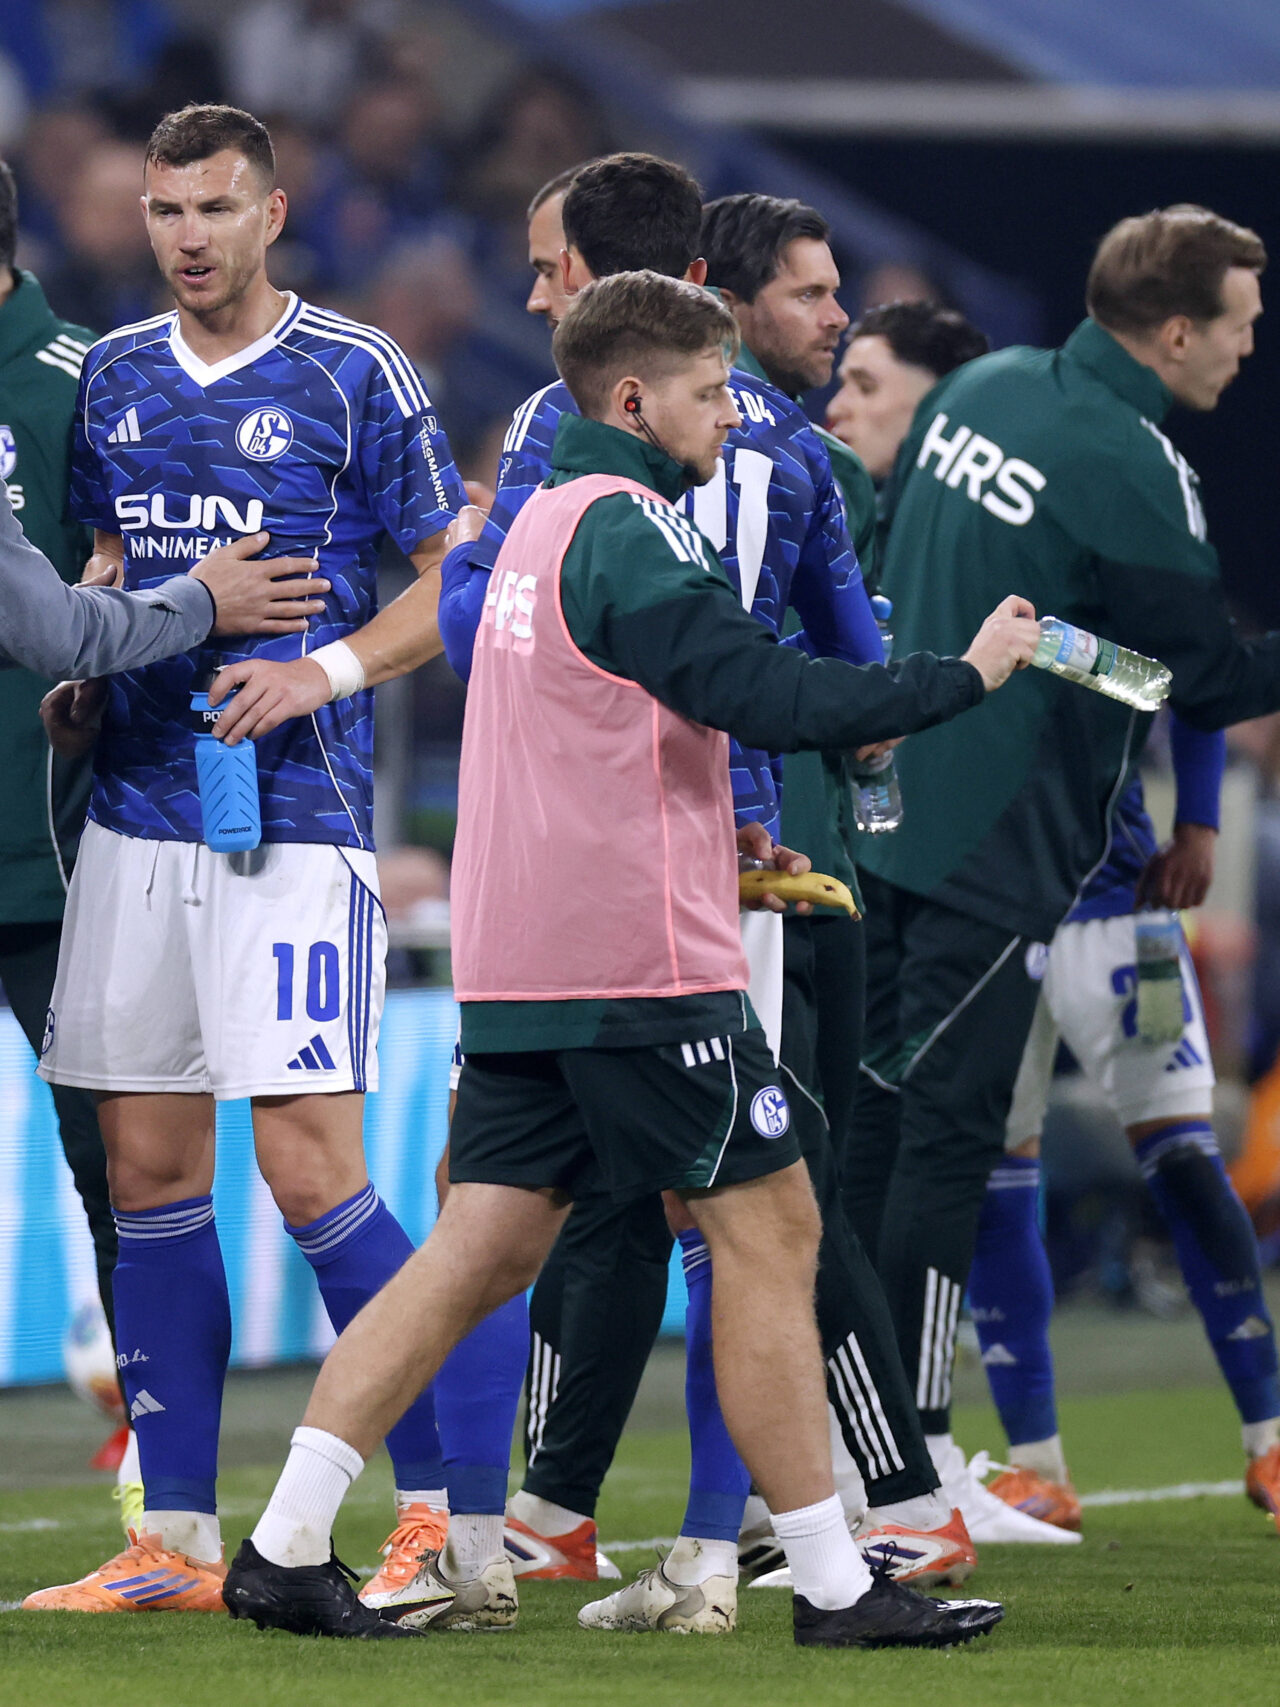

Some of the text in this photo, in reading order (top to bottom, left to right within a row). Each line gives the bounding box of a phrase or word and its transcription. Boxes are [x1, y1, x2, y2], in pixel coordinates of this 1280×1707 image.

[6, 484, 25, 511] S
[419, 427, 450, 511] HEGMANNS
[916, 411, 1047, 526] HRS
[114, 492, 264, 534] SUN
[203, 711, 225, 723] PO
[272, 940, 341, 1022] 10
